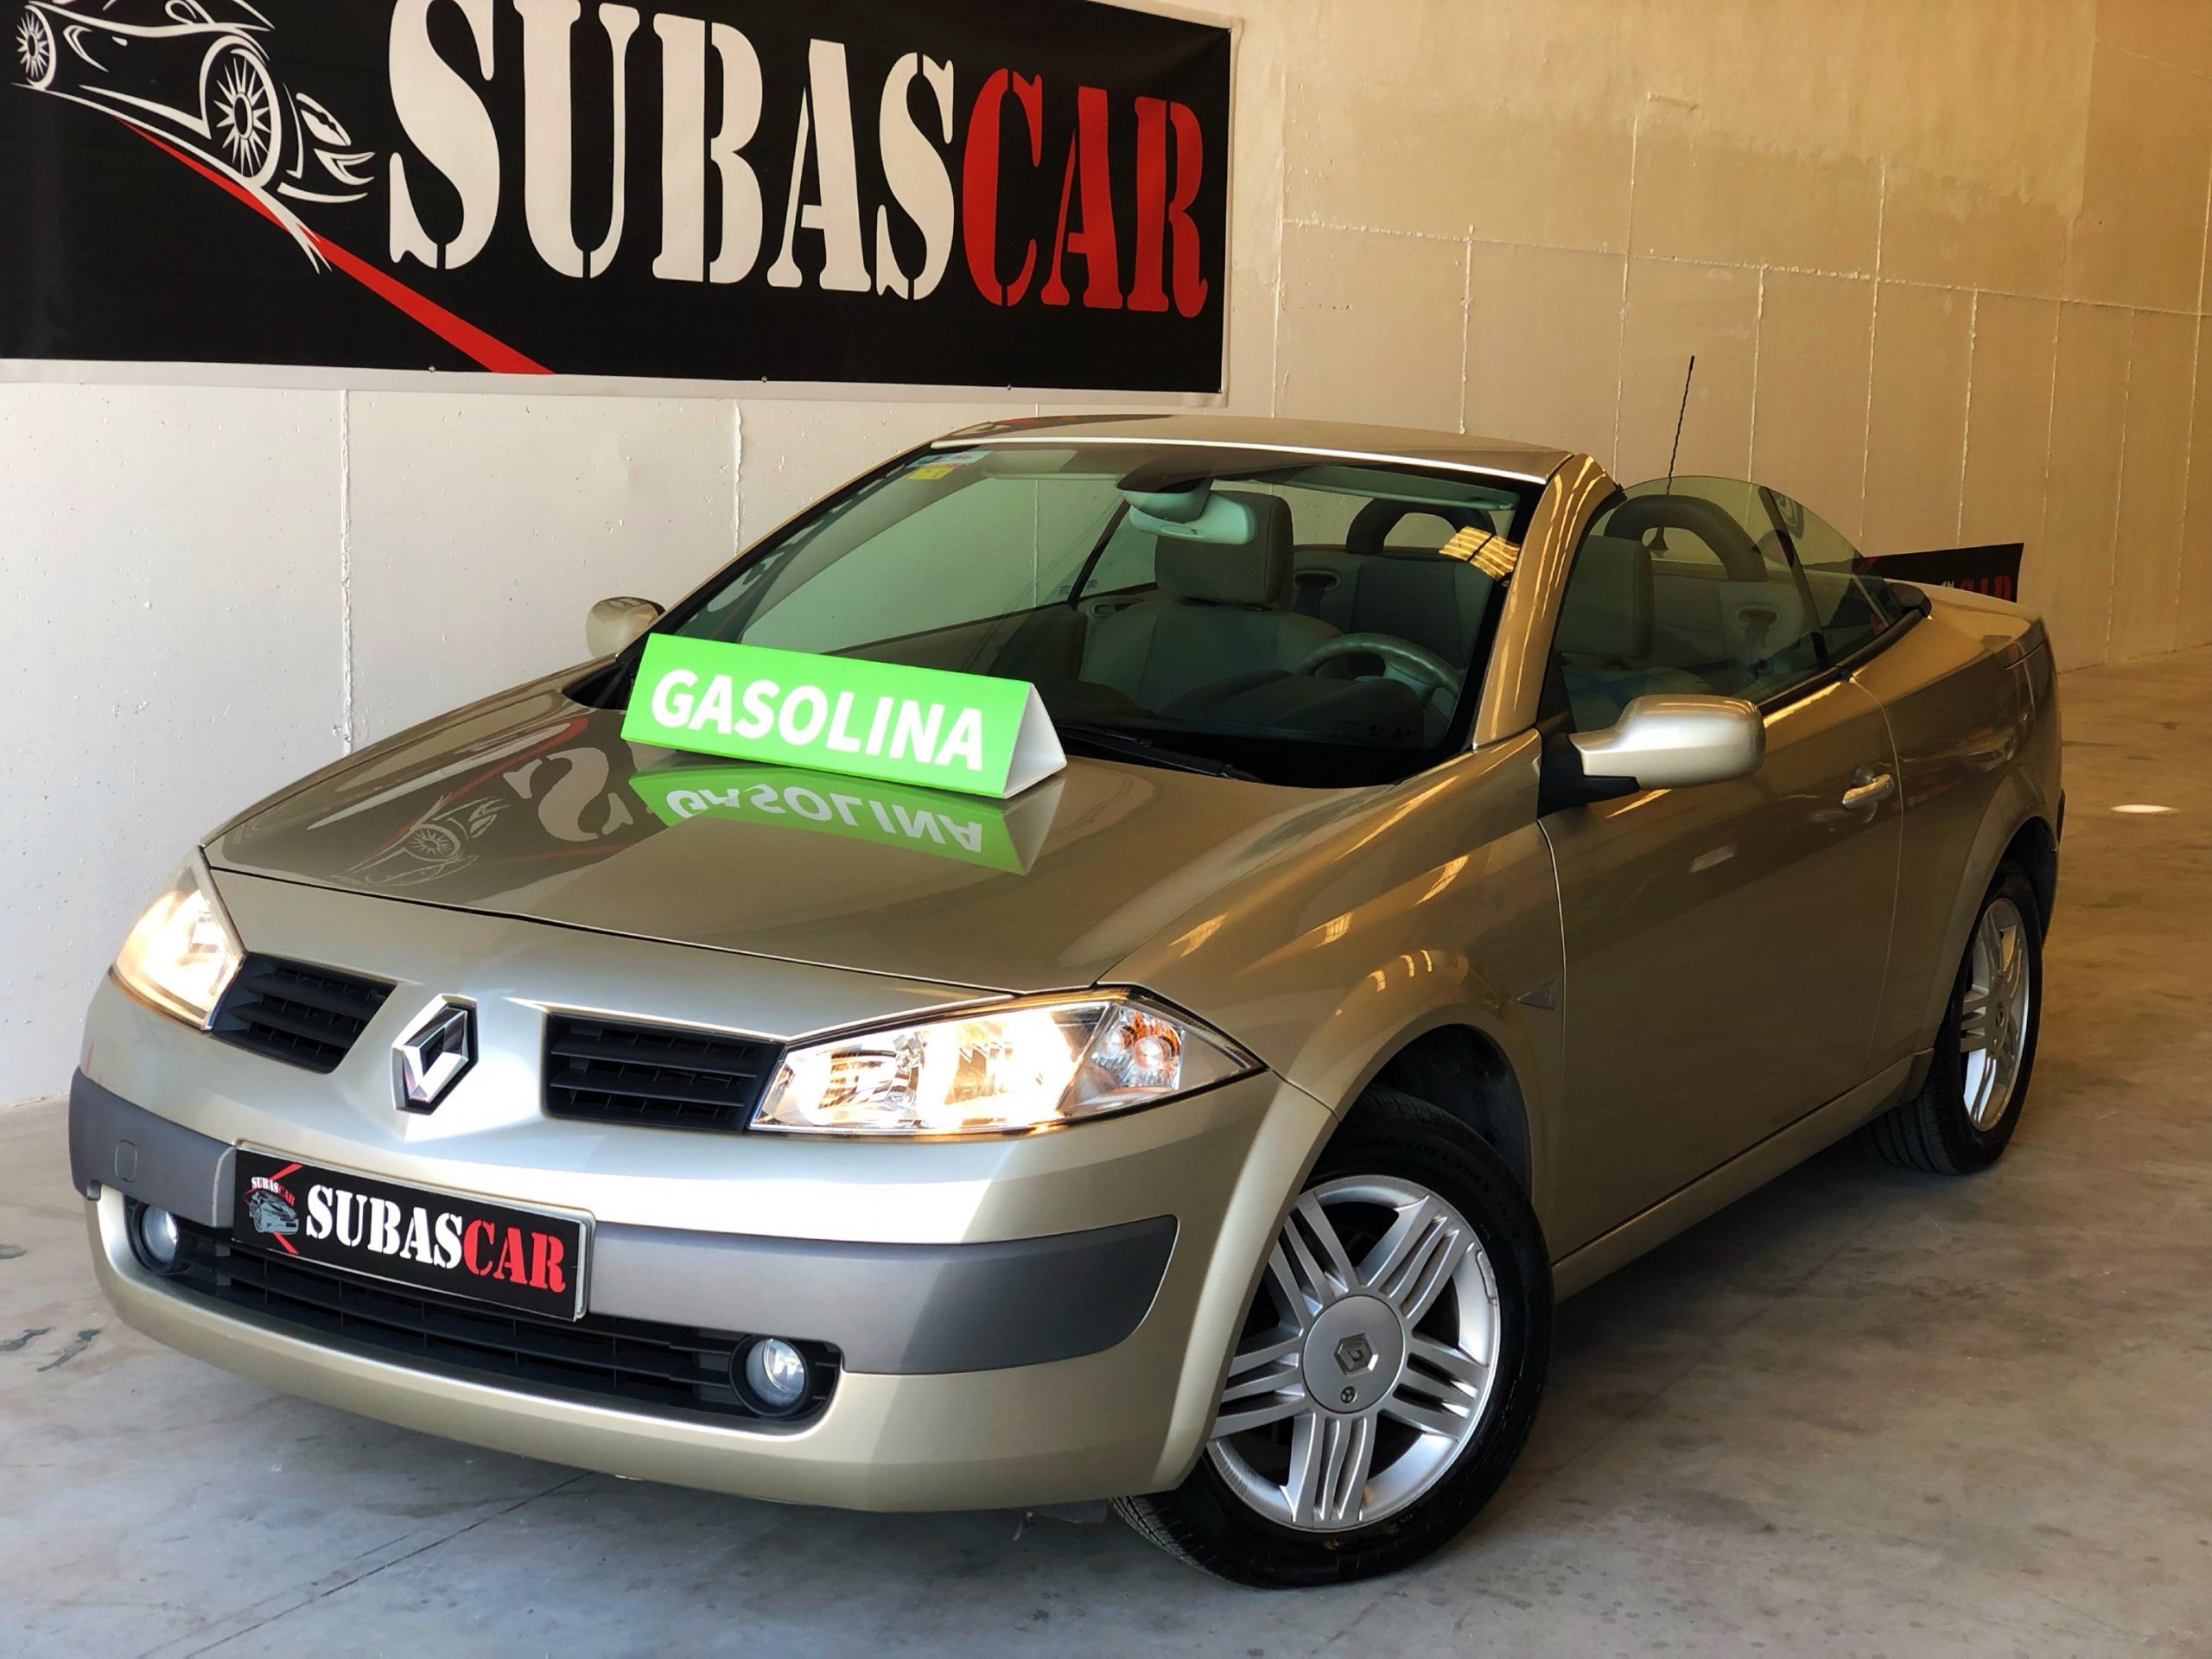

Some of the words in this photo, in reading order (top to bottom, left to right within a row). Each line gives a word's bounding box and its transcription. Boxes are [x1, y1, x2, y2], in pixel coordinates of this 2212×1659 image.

[388, 0, 1209, 318] SUBASCAR
[651, 668, 984, 772] GASOLINA
[251, 1176, 296, 1207] SUBASCAR
[306, 1184, 566, 1294] SUBASCAR
